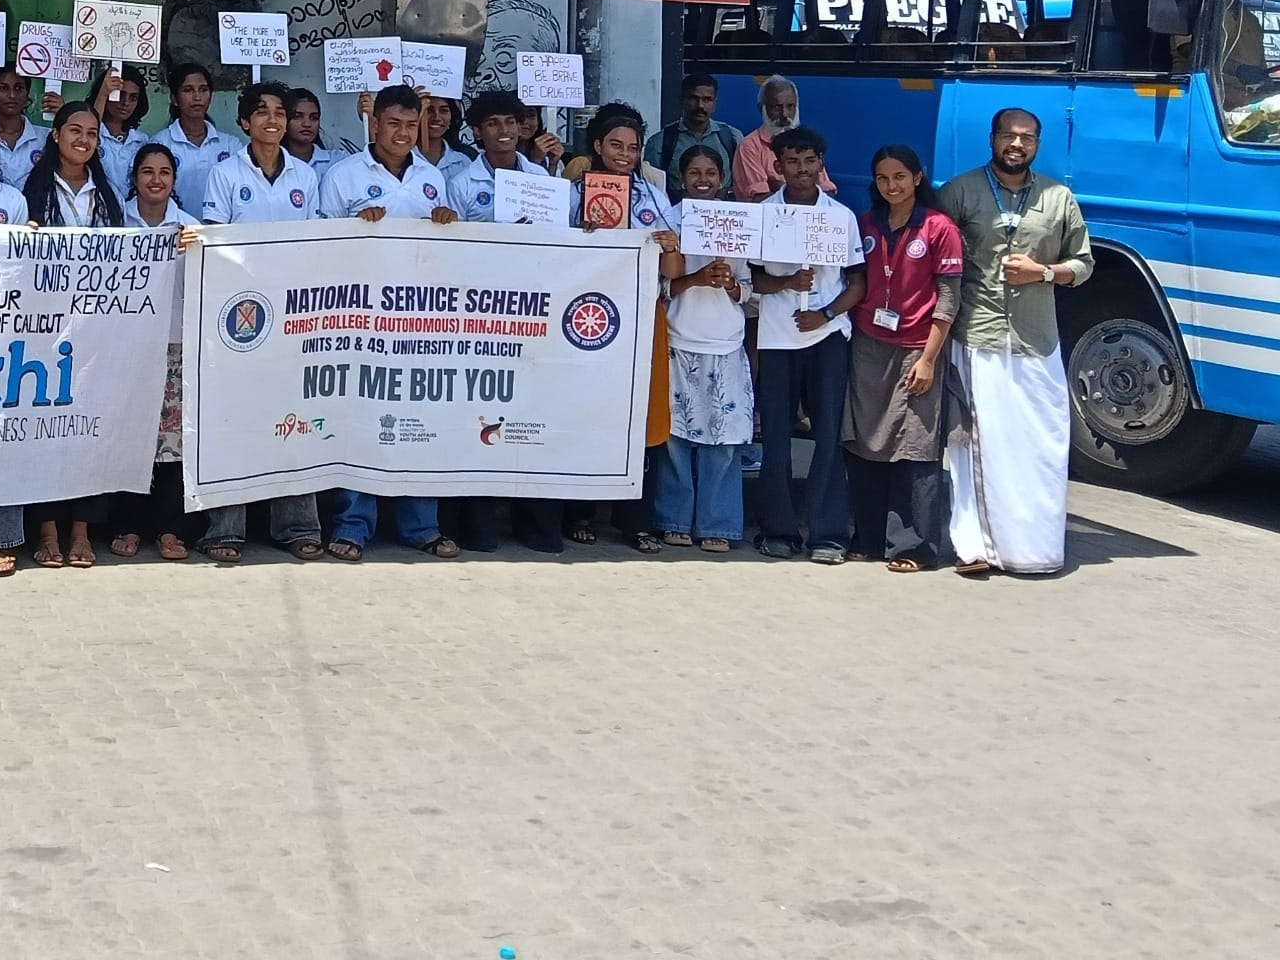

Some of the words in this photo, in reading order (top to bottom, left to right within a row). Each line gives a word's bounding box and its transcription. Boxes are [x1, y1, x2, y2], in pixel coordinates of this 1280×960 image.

[22, 25, 53, 36] DRUGS
[234, 27, 248, 35] THE
[247, 38, 258, 46] THE
[522, 55, 534, 66] BE
[535, 70, 548, 81] BE
[522, 85, 534, 98] BE
[6, 231, 74, 260] NATIONAL
[78, 233, 126, 262] SERVICE
[70, 293, 156, 316] KERALA
[285, 283, 373, 315] NATIONAL
[380, 285, 460, 314] SERVICE
[464, 288, 551, 318] SCHEME
[14, 314, 64, 334] CALICUT
[284, 315, 320, 335] CHRIST
[322, 314, 370, 331] COLLEGE
[374, 315, 461, 334] (AUTONOMOUS)
[463, 317, 548, 337] IRINJALAKUDA
[303, 364, 350, 400] NOT
[358, 365, 401, 401] ME
[410, 369, 454, 402] BUT
[465, 369, 515, 403] YOU
